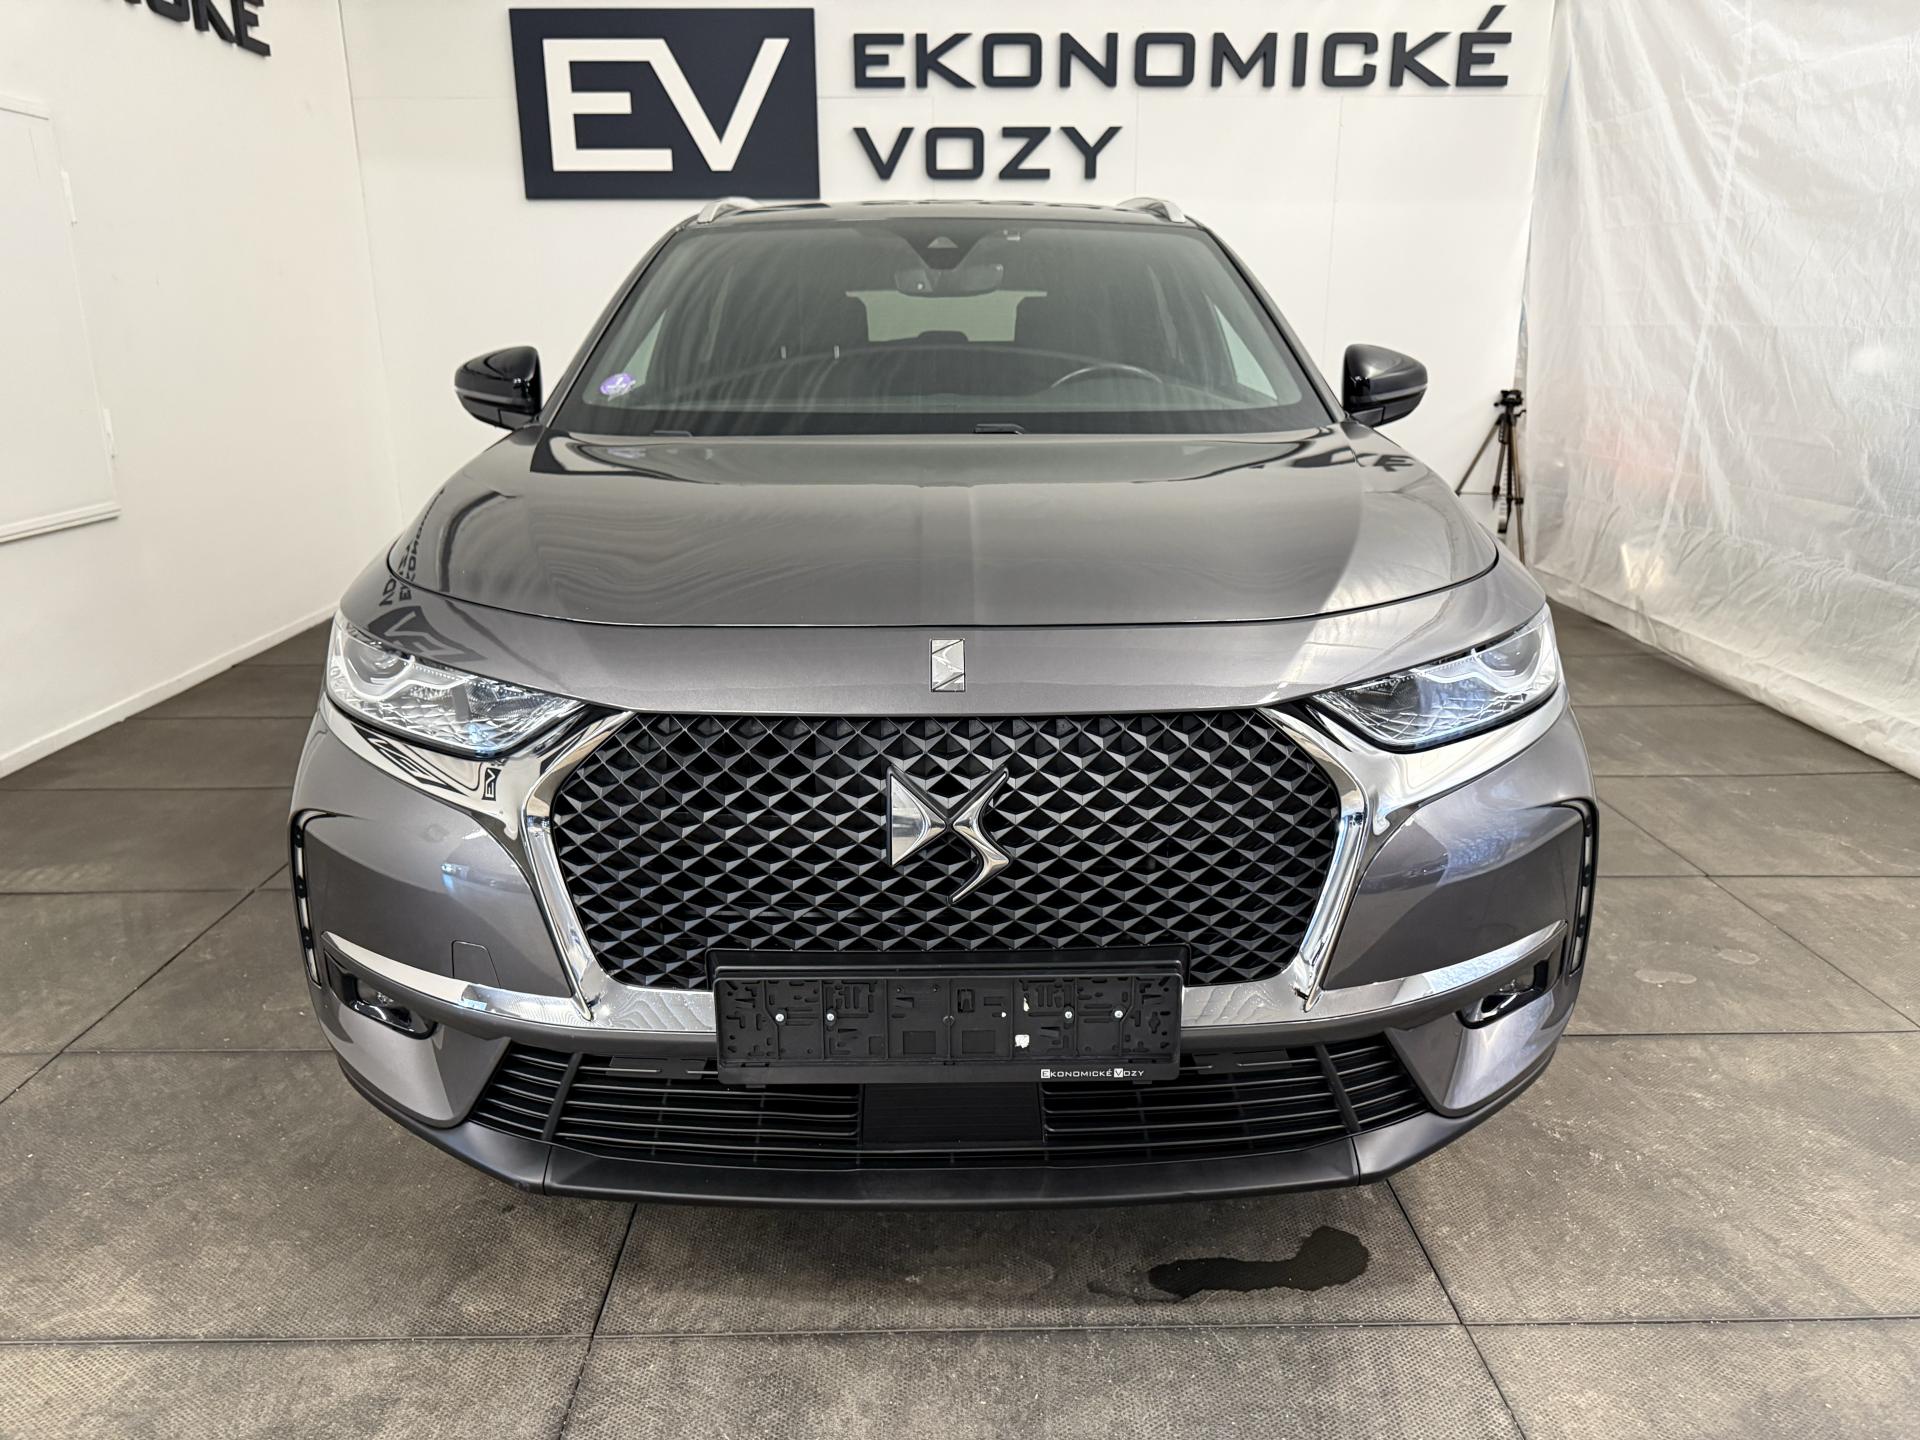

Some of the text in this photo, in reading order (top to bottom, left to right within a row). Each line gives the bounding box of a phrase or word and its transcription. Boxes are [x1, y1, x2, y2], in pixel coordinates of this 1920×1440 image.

[853, 5, 1513, 89] EKONOMICKÉ
[543, 38, 790, 172] EV
[853, 126, 1122, 180] VOZY
[1040, 1067, 1145, 1079] EKONOMICKÉ VOZY
